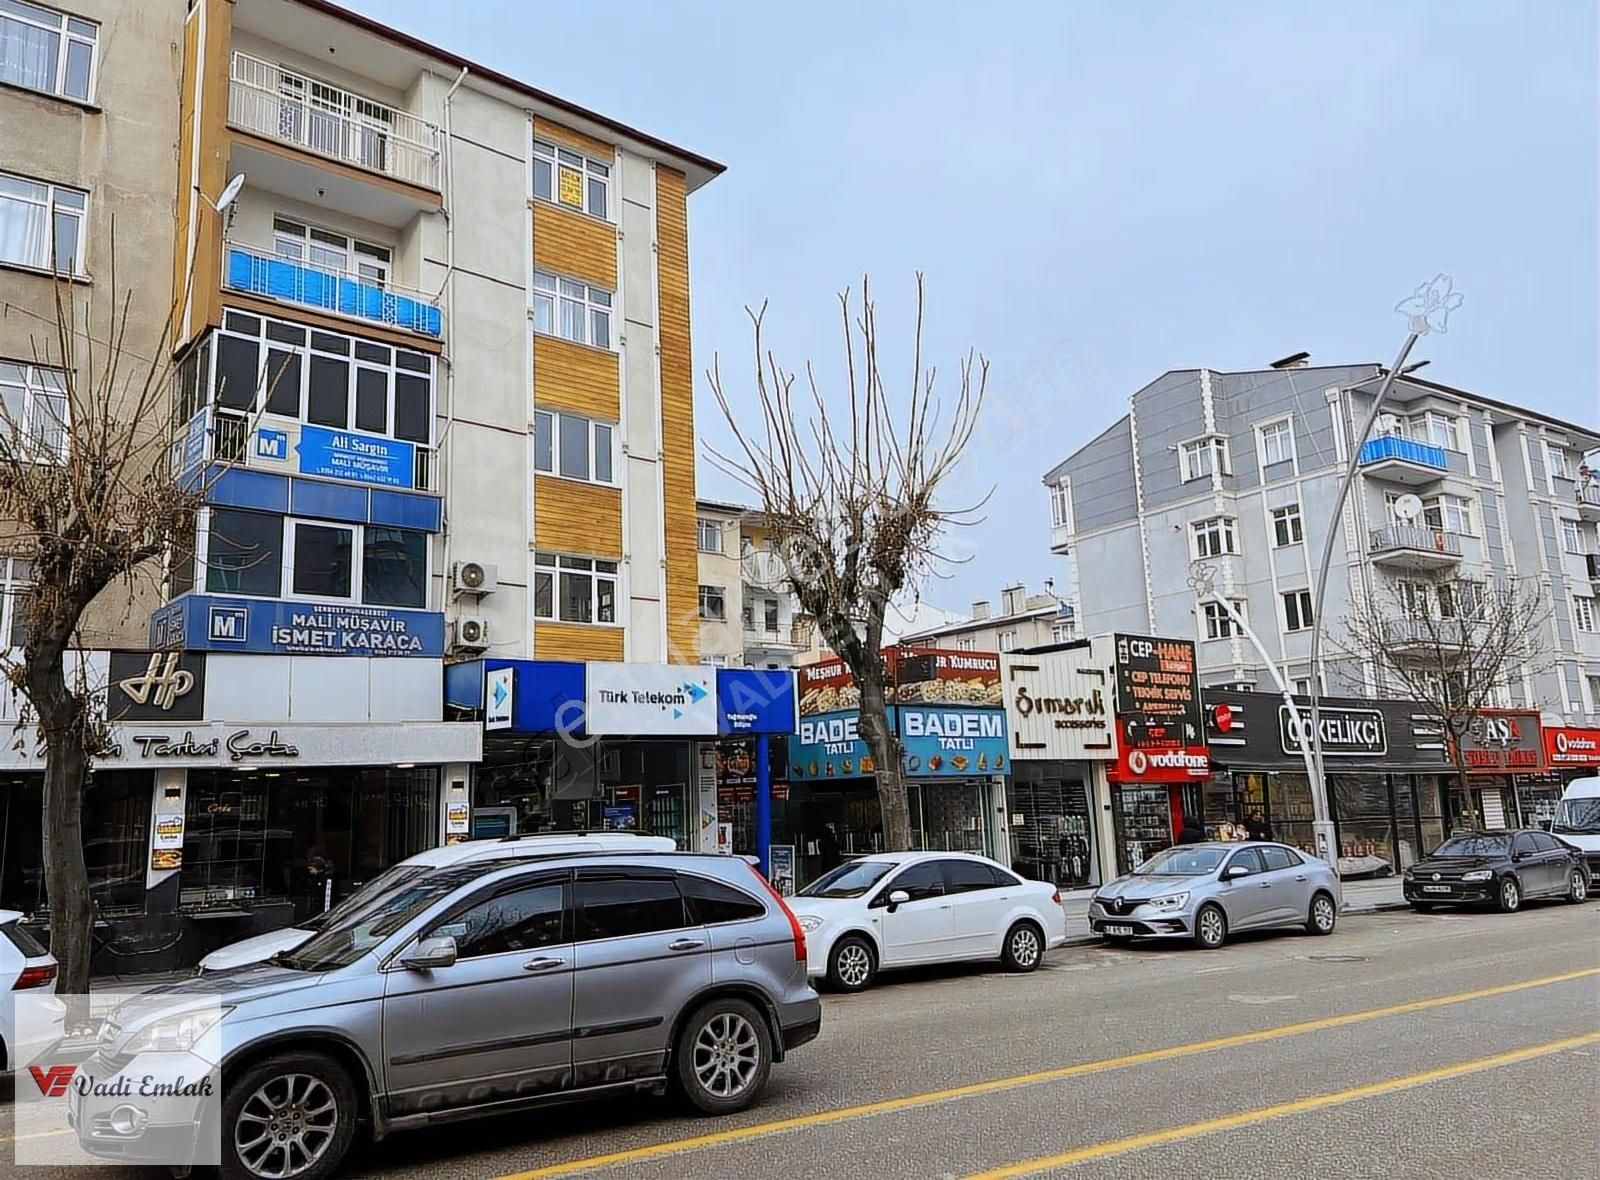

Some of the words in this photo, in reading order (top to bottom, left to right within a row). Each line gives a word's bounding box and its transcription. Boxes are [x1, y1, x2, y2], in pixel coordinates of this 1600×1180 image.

[331, 434, 348, 449] Ali
[292, 614, 332, 628] MALİ
[337, 615, 405, 632] MÜŞAVİR
[272, 625, 336, 646] İSMET
[342, 632, 422, 650] KARACA
[806, 663, 842, 681] MEŞHUR
[599, 690, 628, 703] Türk
[632, 690, 685, 704] Telekom
[801, 717, 859, 744] BADE
[905, 712, 1003, 737] BADEM
[825, 742, 855, 756] TATLI
[938, 737, 975, 750] TATLI
[1148, 750, 1208, 767] vodafone
